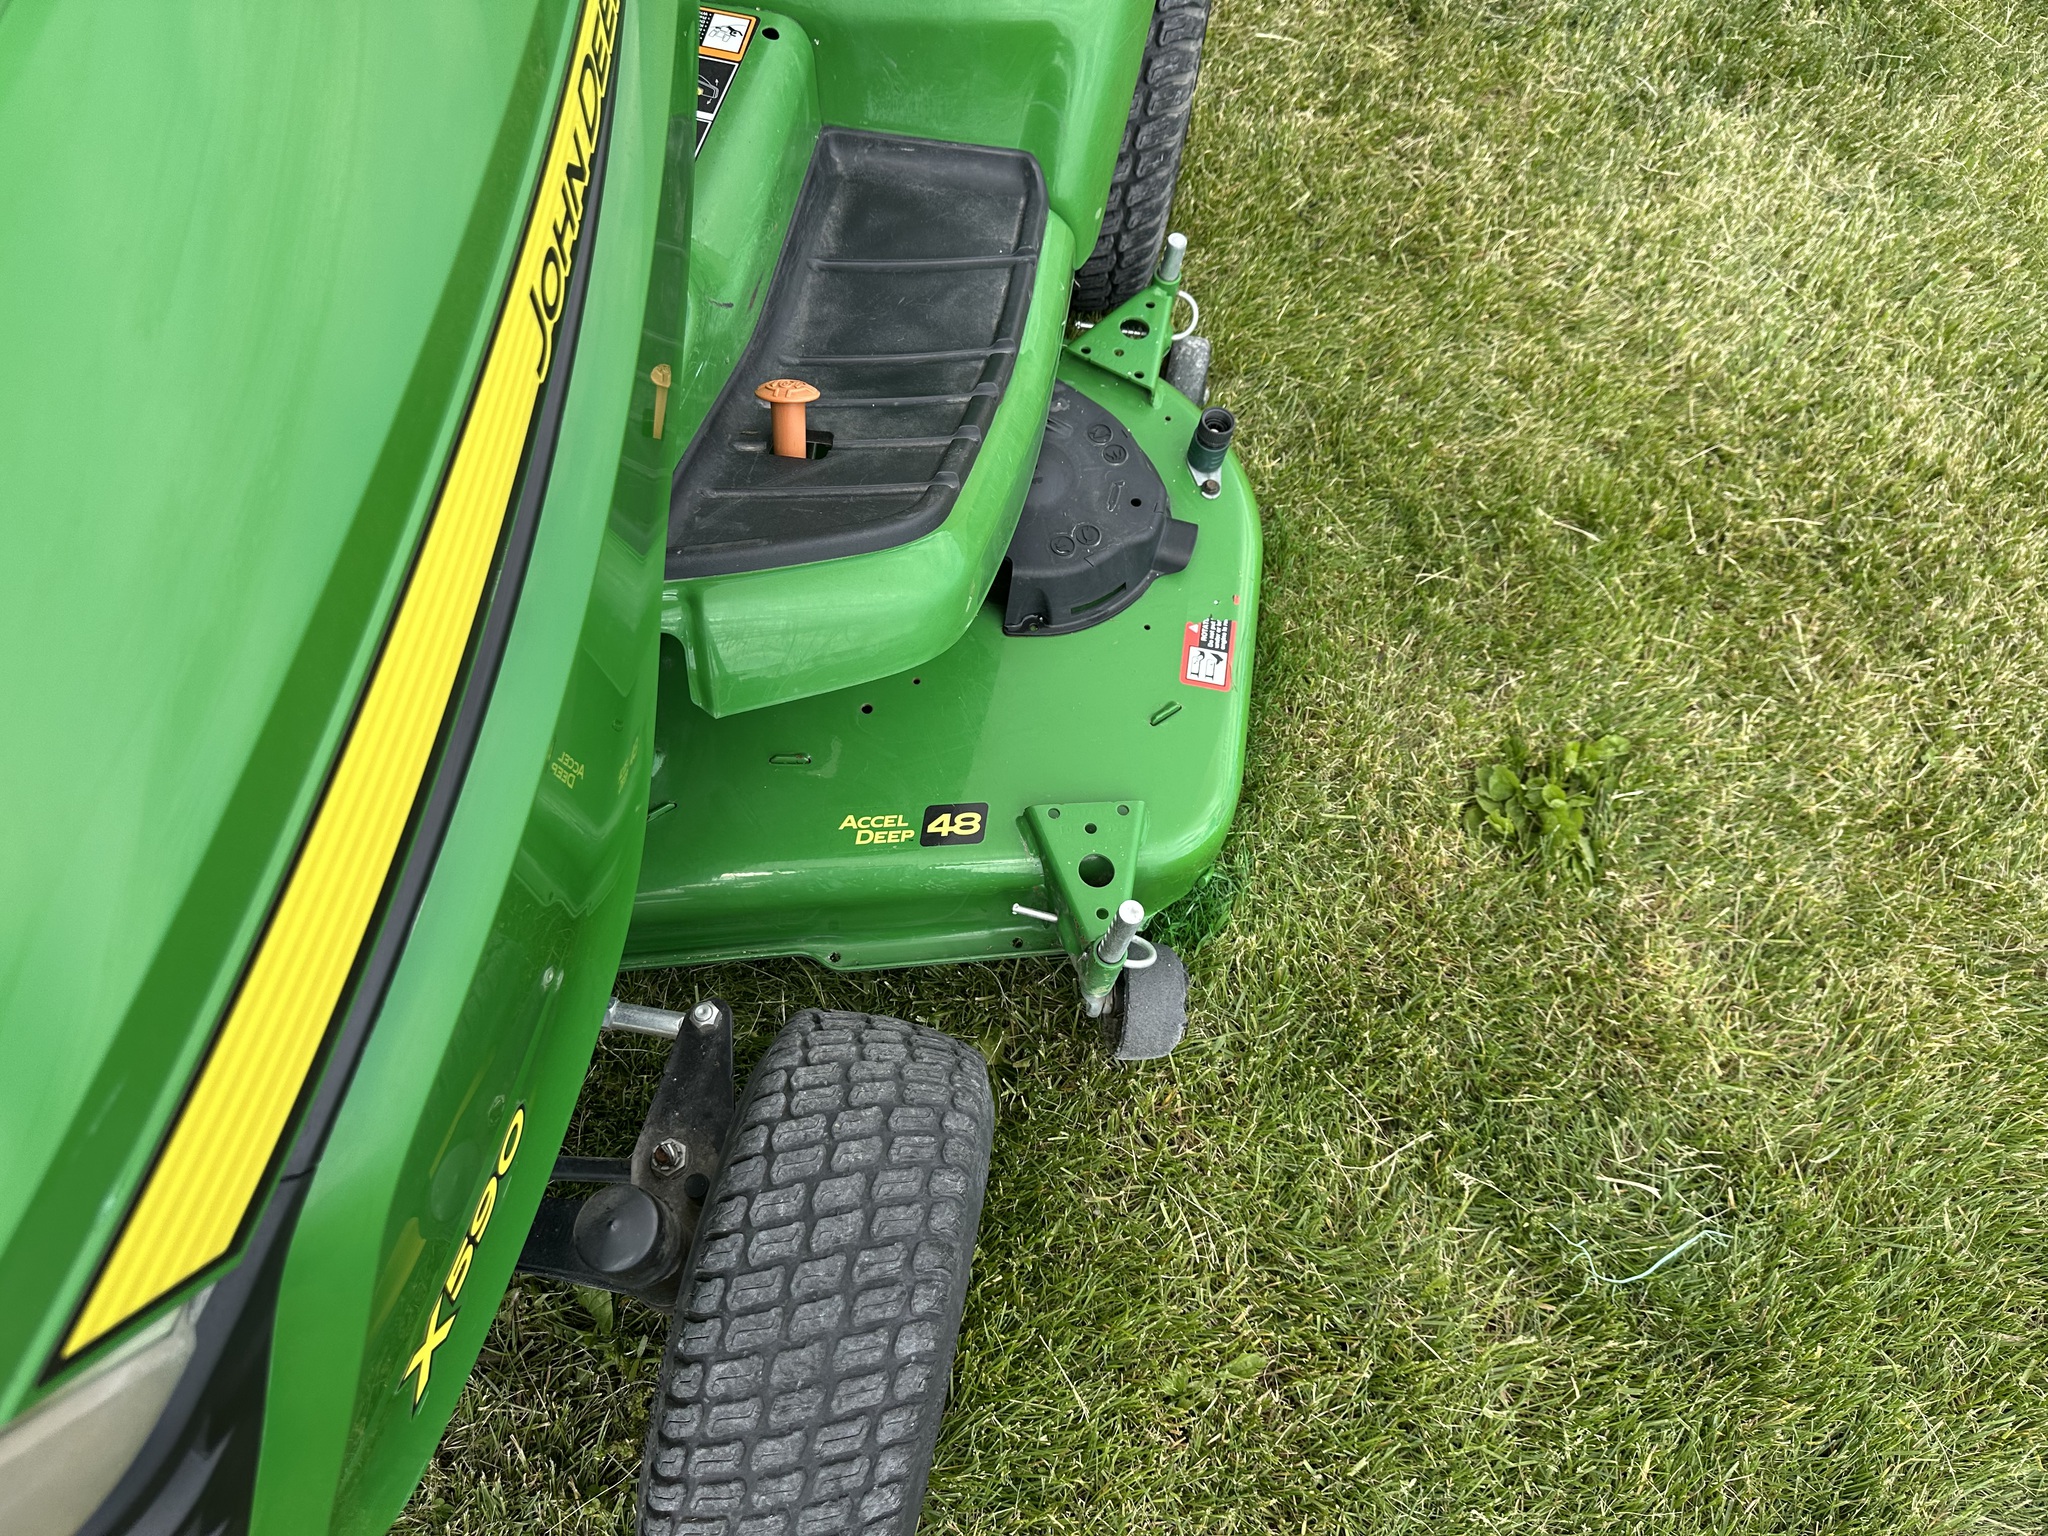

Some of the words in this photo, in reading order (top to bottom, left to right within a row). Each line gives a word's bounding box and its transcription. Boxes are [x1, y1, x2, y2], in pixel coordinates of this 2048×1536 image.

[529, 126, 588, 379] JOHN
[578, 0, 619, 148] DEE
[838, 814, 909, 830] ACCEL
[926, 811, 982, 837] 48
[855, 829, 915, 845] DEEP
[396, 1105, 525, 1416] X590
